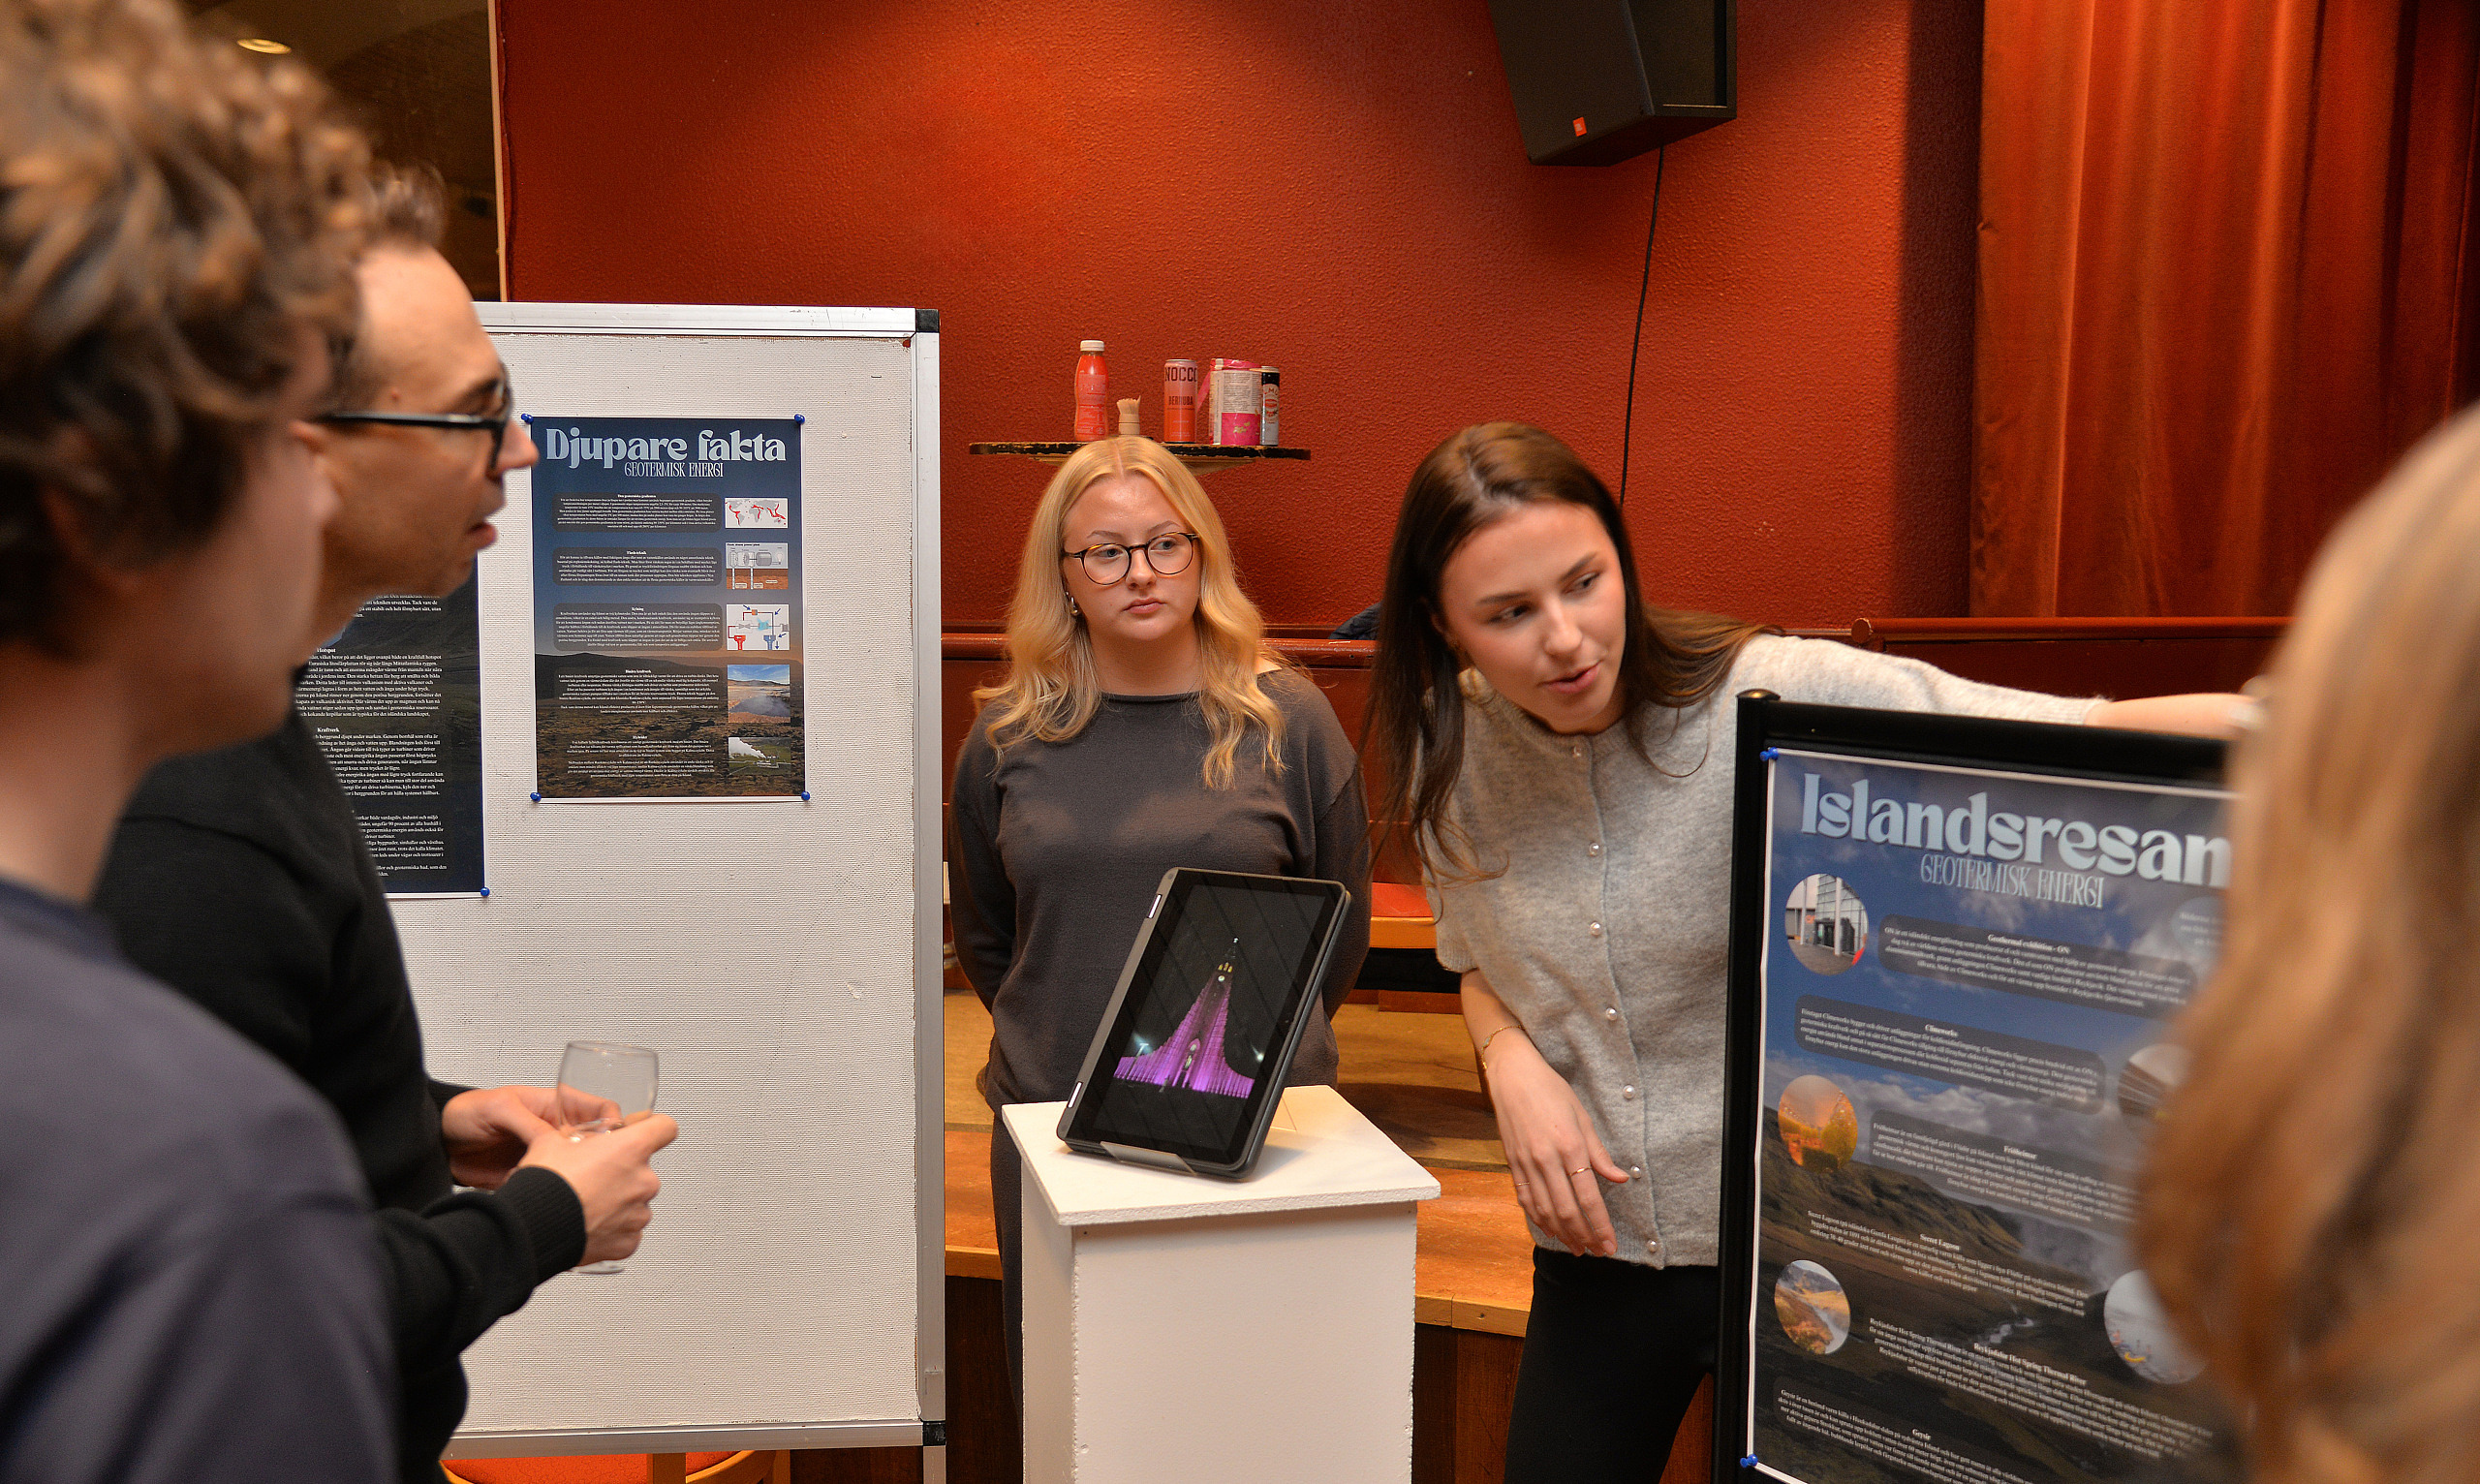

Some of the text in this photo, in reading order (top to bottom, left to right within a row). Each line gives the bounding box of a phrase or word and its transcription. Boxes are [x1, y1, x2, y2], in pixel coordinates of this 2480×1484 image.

[546, 427, 786, 469] Djupare fakta
[624, 463, 724, 477] GEOTERMISK ENERGI
[1801, 773, 2232, 887] Islandsresan
[1921, 854, 2104, 910] GEOTERMISK ENERGI
[1925, 1024, 1958, 1037] Climeworks
[1920, 1233, 1960, 1251] Secret Lagoon
[2009, 1354, 2021, 1364] Hot
[2022, 1358, 2042, 1372] Spring
[2044, 1365, 2069, 1380] Thermal
